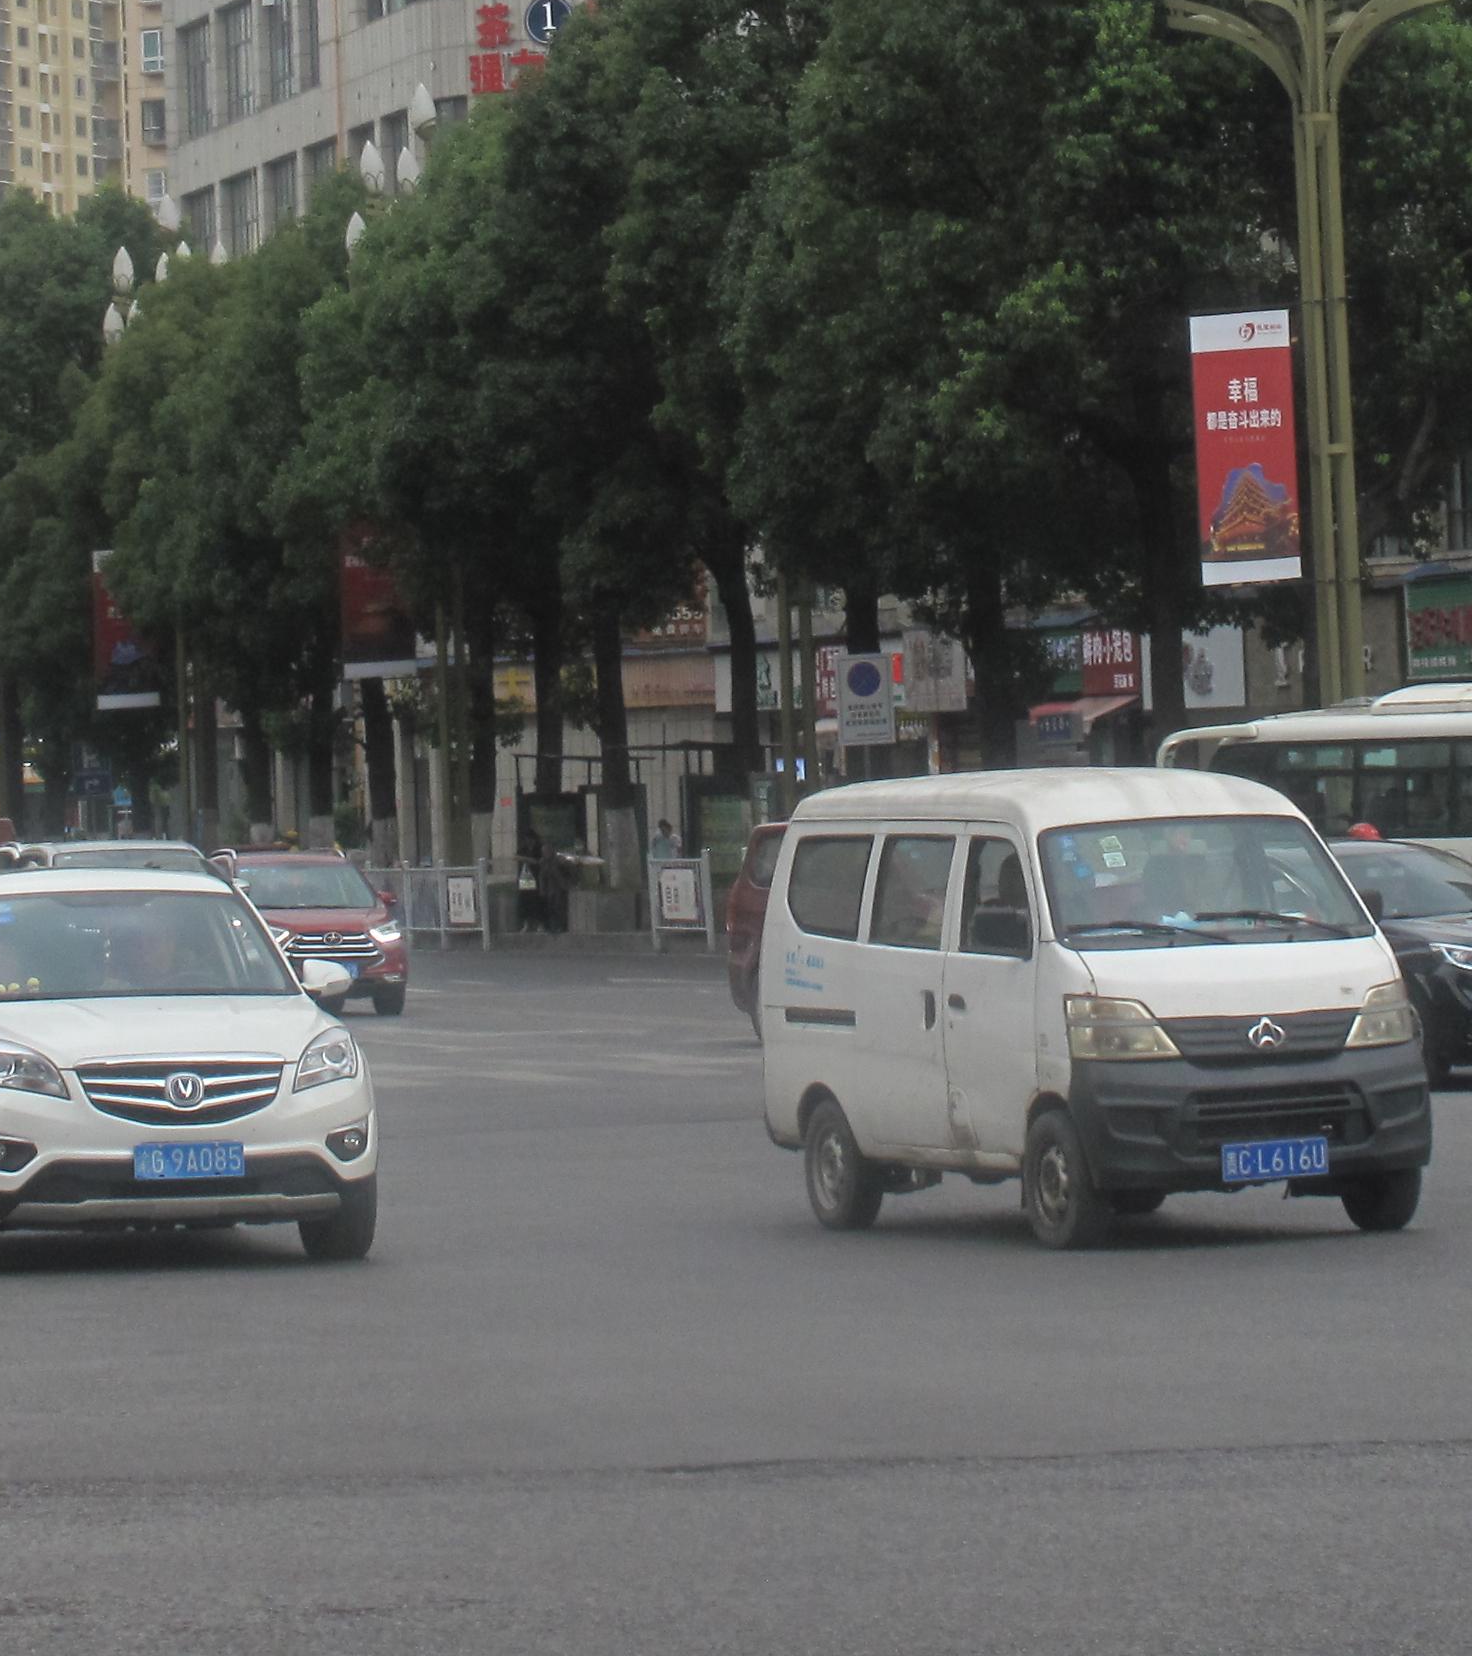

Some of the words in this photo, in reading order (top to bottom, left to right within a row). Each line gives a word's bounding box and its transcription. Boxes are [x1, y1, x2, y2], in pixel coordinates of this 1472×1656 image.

[1228, 377, 1259, 403] 幸福
[1207, 408, 1282, 430] 都是奋斗出来的
